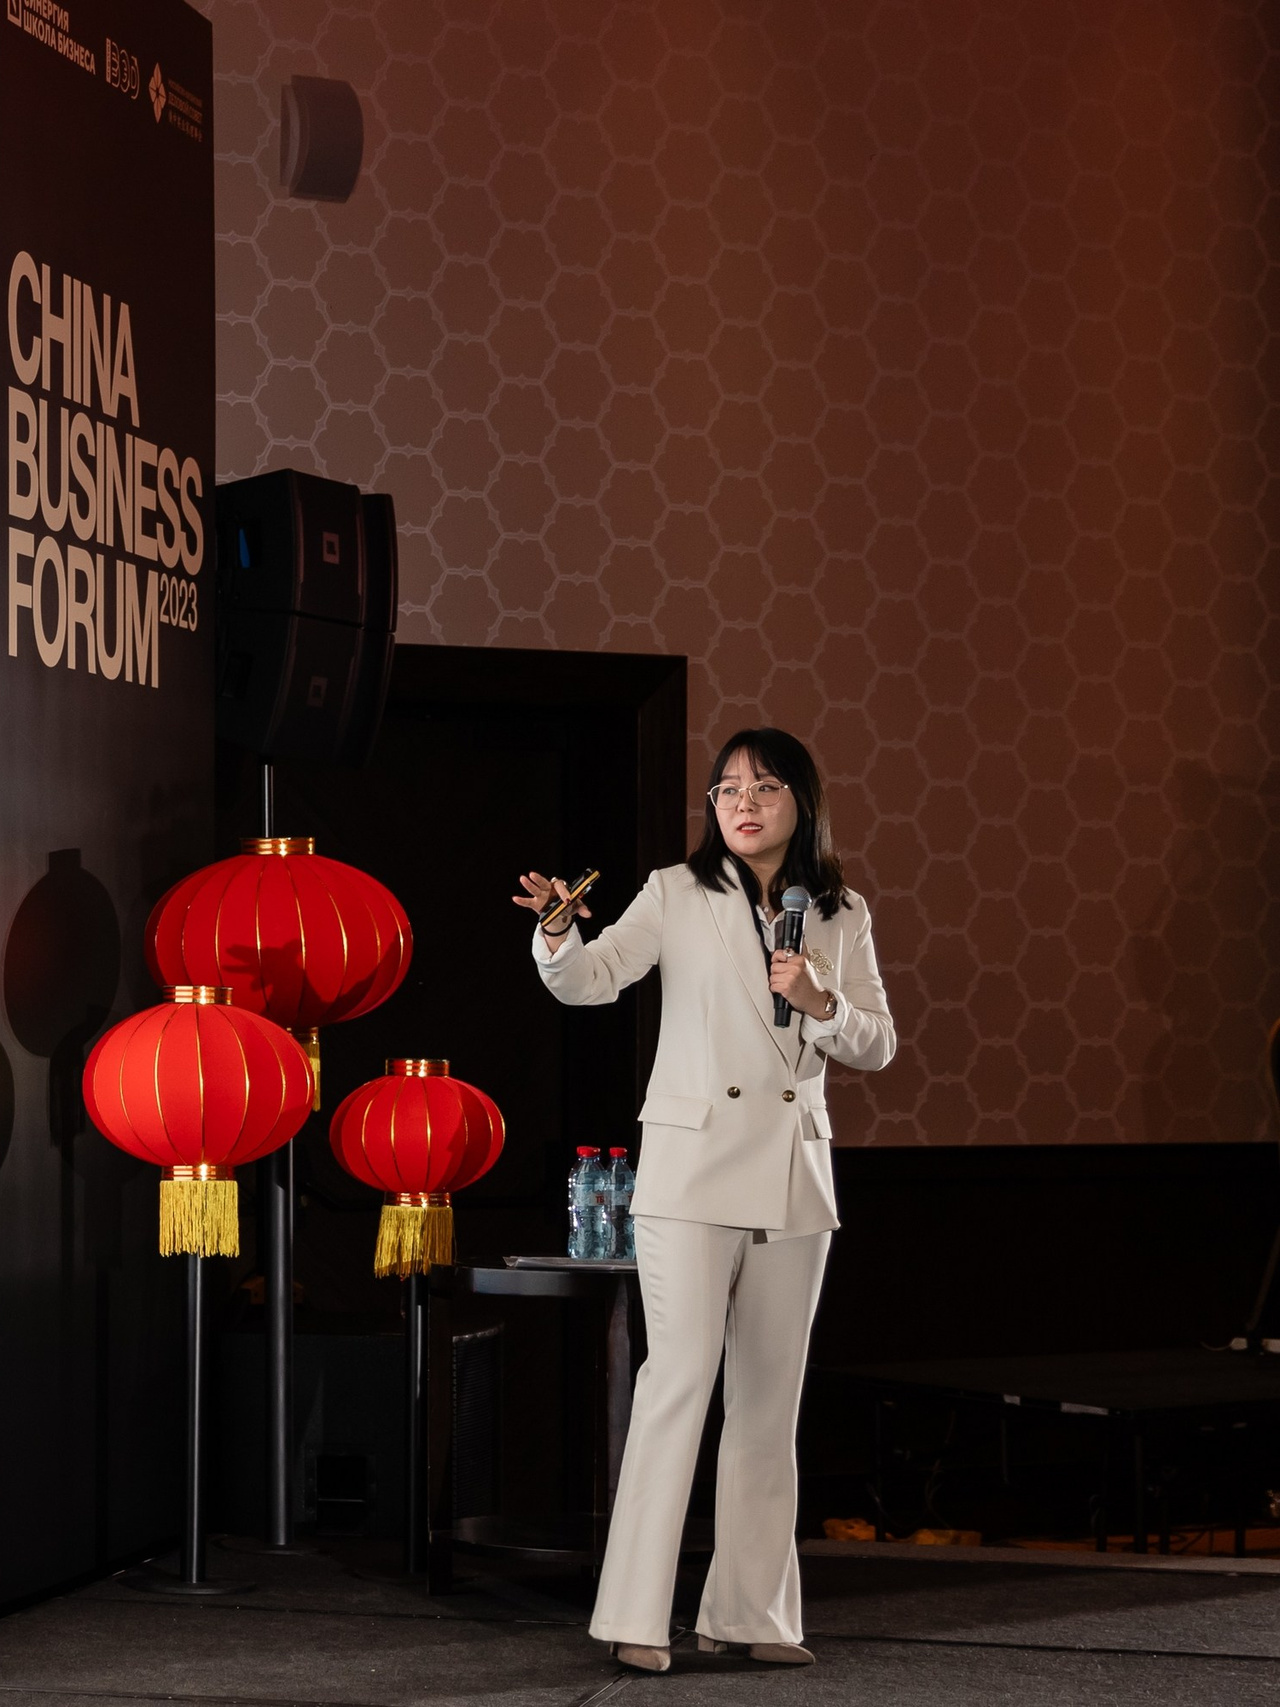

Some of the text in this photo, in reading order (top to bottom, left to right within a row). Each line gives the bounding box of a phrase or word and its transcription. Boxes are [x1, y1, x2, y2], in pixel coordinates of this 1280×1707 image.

[23, 9, 96, 76] ШКОЛА БИЗНЕСА
[8, 250, 139, 428] CHINA
[8, 385, 204, 576] BUSINESS
[8, 527, 197, 688] FORUM 2023
